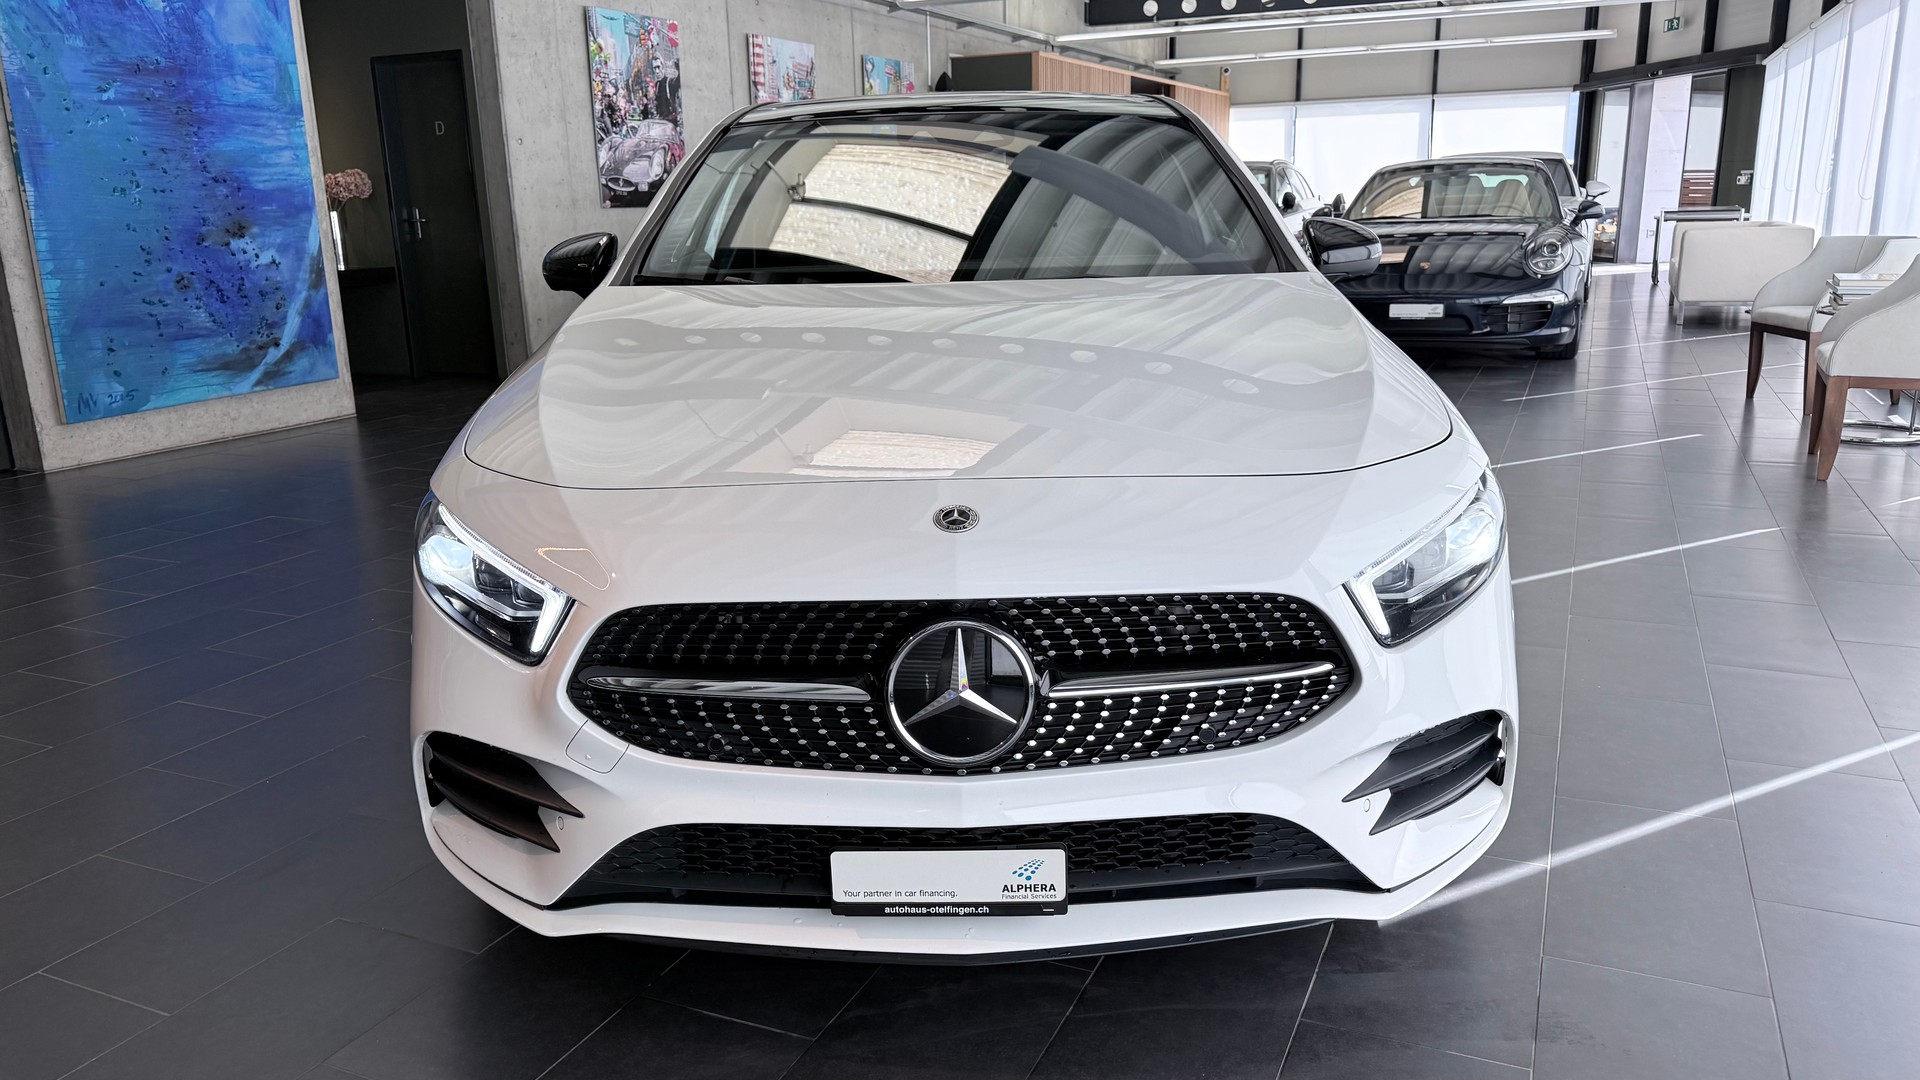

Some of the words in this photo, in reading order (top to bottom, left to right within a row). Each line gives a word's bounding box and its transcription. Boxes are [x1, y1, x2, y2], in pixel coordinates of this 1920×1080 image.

[435, 121, 445, 135] D
[1002, 884, 1057, 892] ALPHERA
[863, 890, 892, 898] partner
[919, 890, 958, 898] financing.
[884, 905, 990, 915] autohaus-otelfingen.ch
